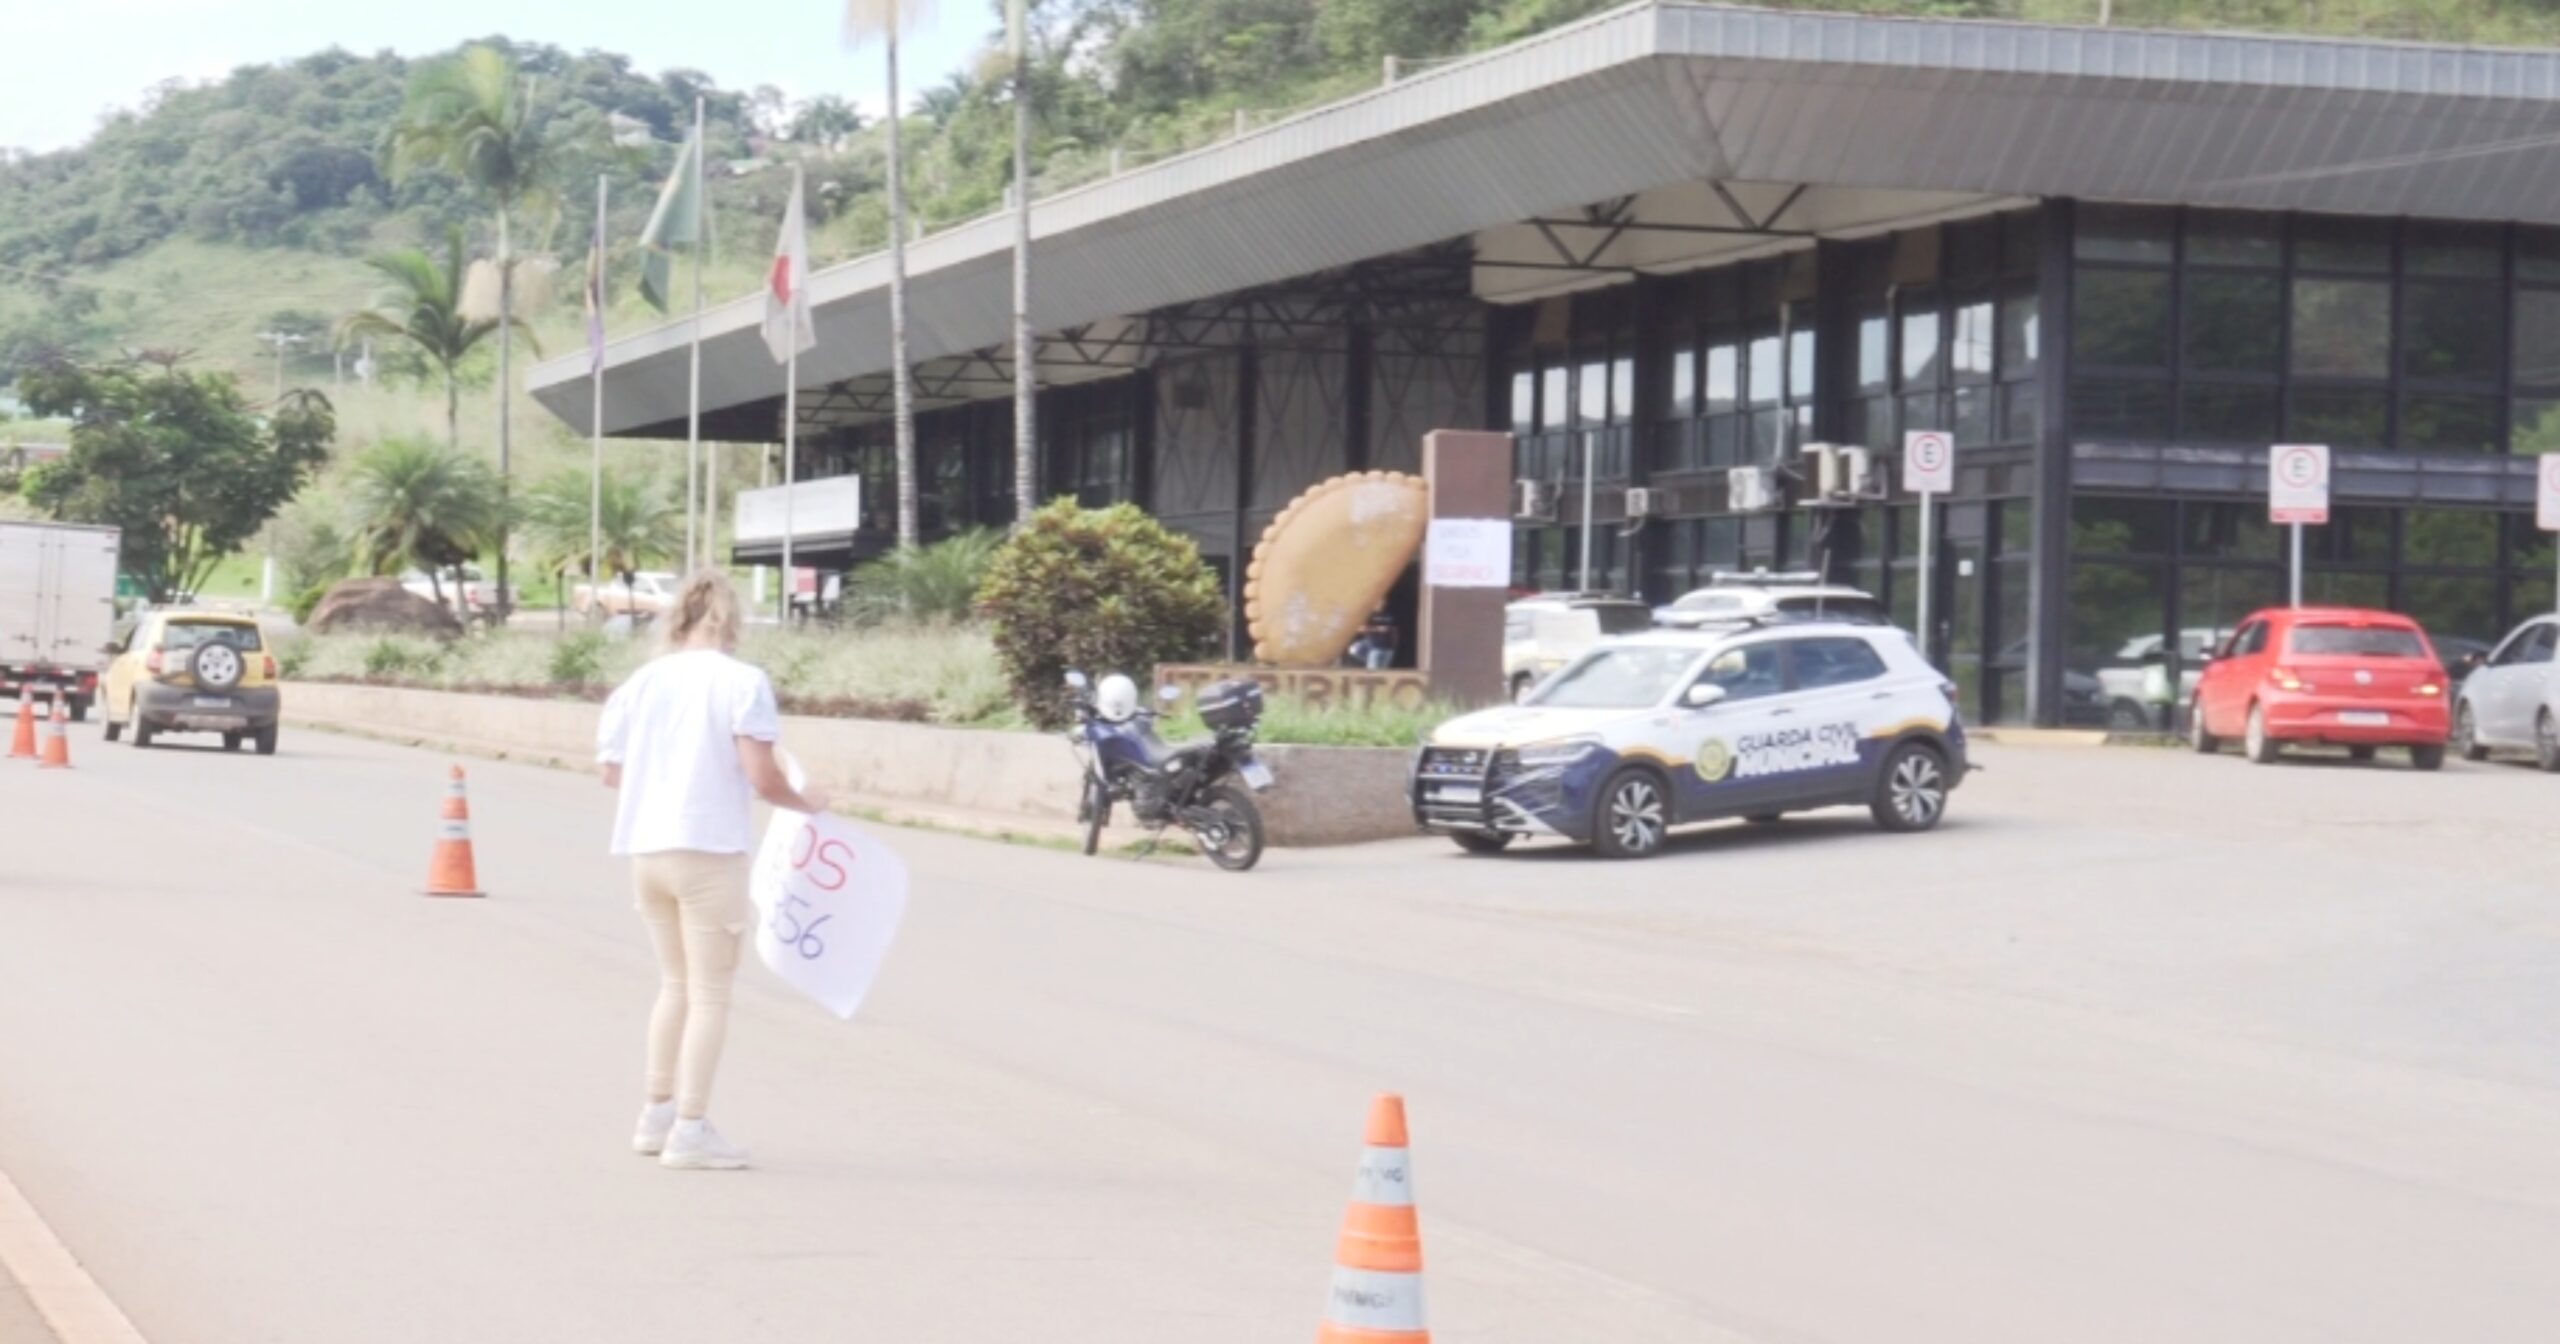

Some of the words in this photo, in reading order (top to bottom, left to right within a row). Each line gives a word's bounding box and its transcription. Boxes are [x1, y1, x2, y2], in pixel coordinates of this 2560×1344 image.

[1923, 443, 1938, 464] E
[1738, 729, 1811, 752] GUARDA
[1819, 722, 1859, 742] CIVIL
